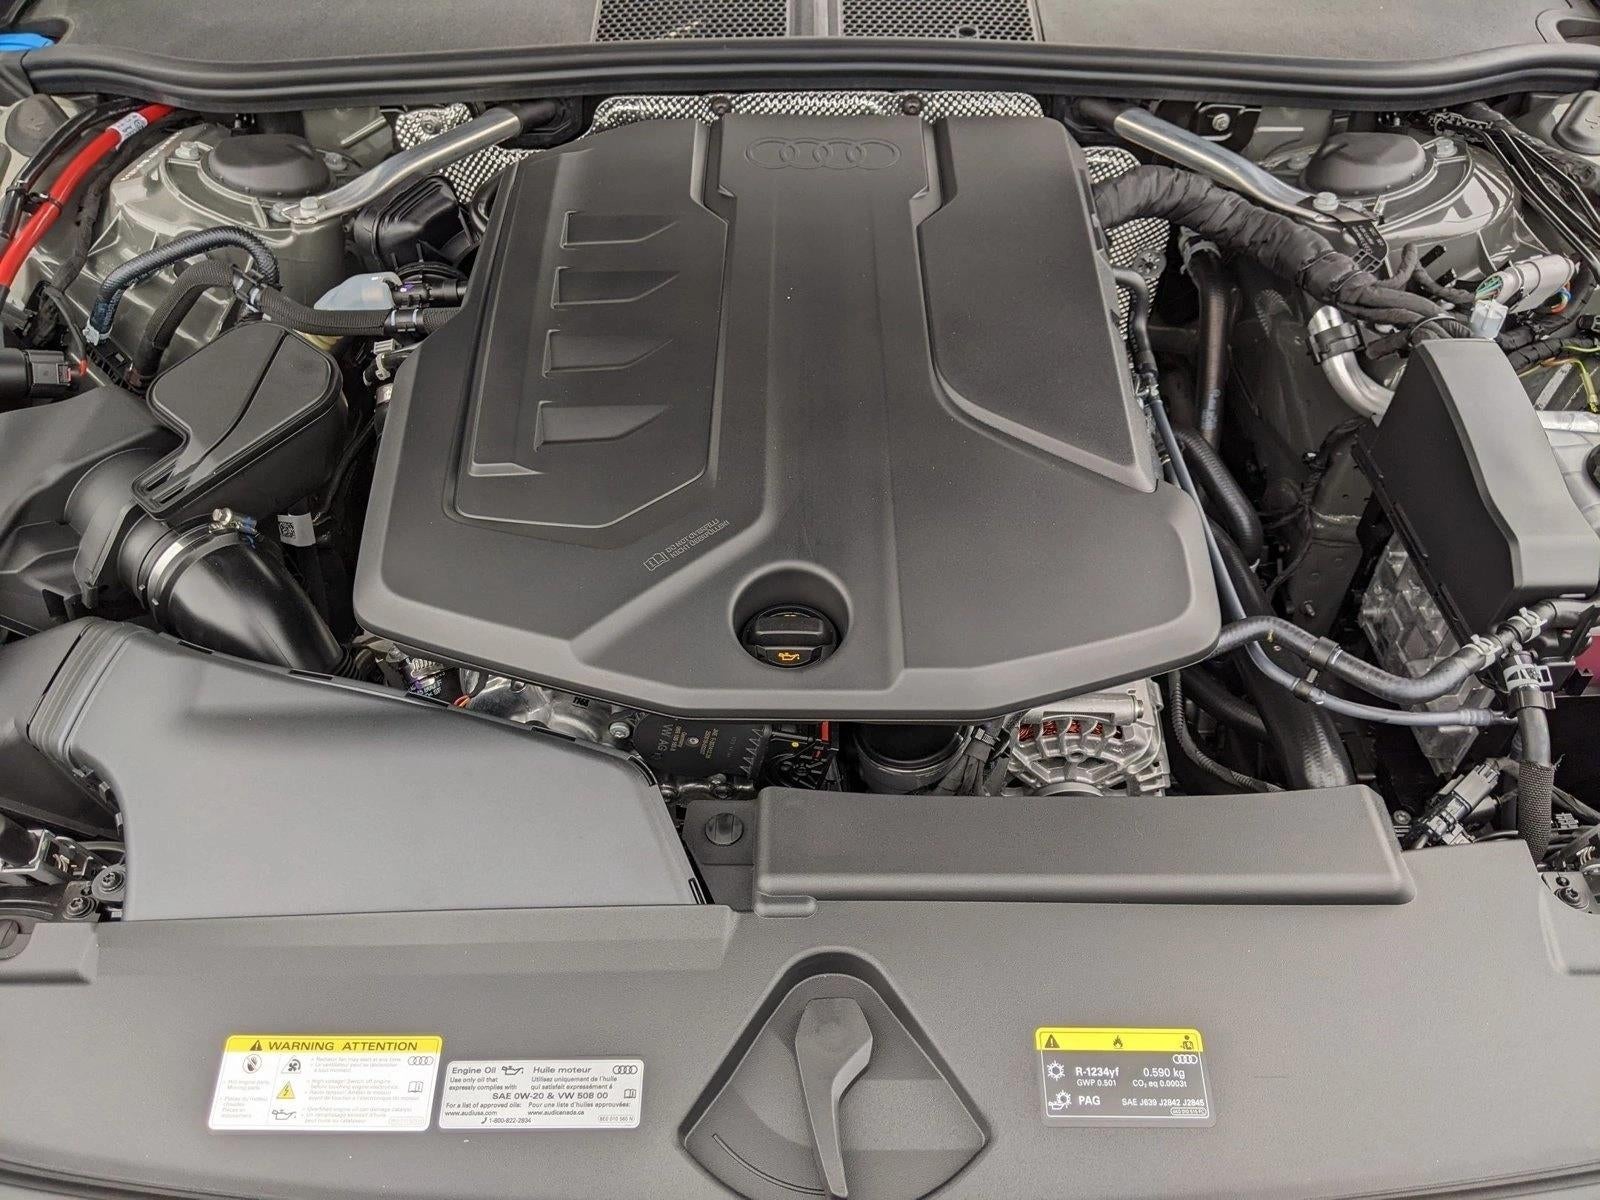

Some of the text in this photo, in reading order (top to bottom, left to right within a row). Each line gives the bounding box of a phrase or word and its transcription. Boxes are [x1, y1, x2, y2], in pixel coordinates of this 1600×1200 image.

[268, 1041, 418, 1051] WARNING ATTENTION
[452, 1067, 482, 1075] Engine
[533, 1066, 555, 1074] Huile
[1076, 1067, 1120, 1079] R-1234yf
[1143, 1067, 1185, 1080] 0.590 kg
[1077, 1079, 1117, 1087] GWP 0.501
[1148, 1081, 1158, 1089] eq
[1159, 1080, 1188, 1088] 0.0003t
[492, 1092, 512, 1100] SAE
[513, 1092, 544, 1100] 0W-20
[546, 1092, 555, 1100] &
[1078, 1096, 1101, 1105] PAG
[480, 1102, 508, 1110] approved
[1122, 1098, 1205, 1107] SAE J639 J2842 J2845
